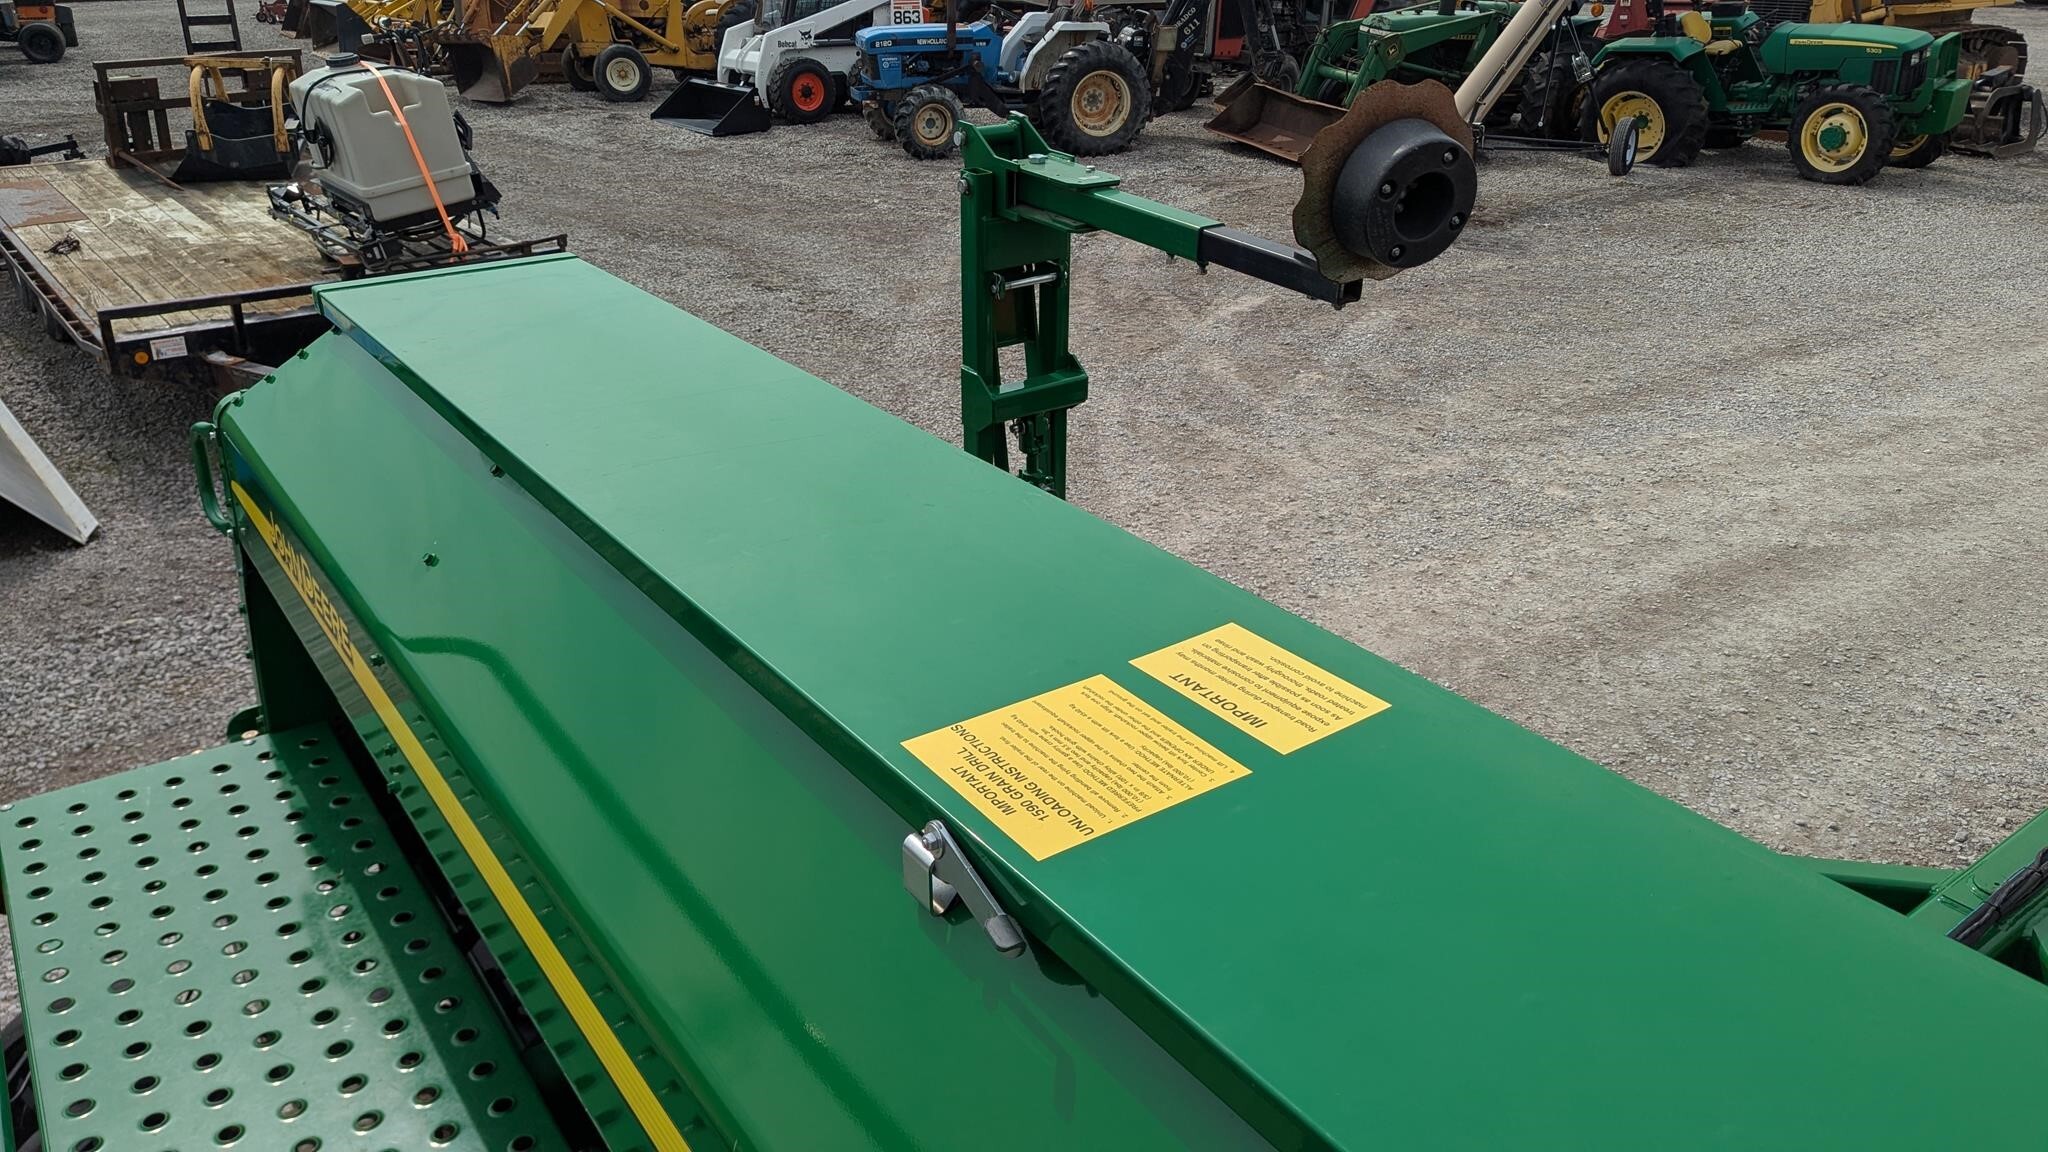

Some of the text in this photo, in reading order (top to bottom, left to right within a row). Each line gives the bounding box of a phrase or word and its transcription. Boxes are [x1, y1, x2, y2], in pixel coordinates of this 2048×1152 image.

[894, 10, 920, 24] 863
[1184, 18, 1200, 35] 611
[778, 40, 797, 48] Bobcat
[299, 552, 353, 665] DEERE
[1214, 639, 1233, 649] rinse
[1211, 647, 1253, 672] transporting
[1245, 655, 1265, 667] wash
[1221, 666, 1255, 684] corrosive
[1251, 671, 1270, 680] after
[1264, 665, 1304, 688] thoroughly
[1302, 674, 1326, 687] avoid
[1175, 651, 1318, 733] Road transport during winter months may
[1269, 680, 1302, 698] possible
[1168, 673, 1268, 728] IMPORTANT
[1261, 688, 1302, 711] equipment
[1310, 702, 1332, 714] soon
[1325, 699, 1356, 716] treated
[1334, 691, 1368, 710] machine
[1301, 710, 1330, 726] expose
[950, 724, 1094, 836] UNLOADING INSTRUCTIONS
[957, 746, 1049, 821] 1590 GRAIN DRILL
[950, 766, 1017, 816] IMPORTANT
